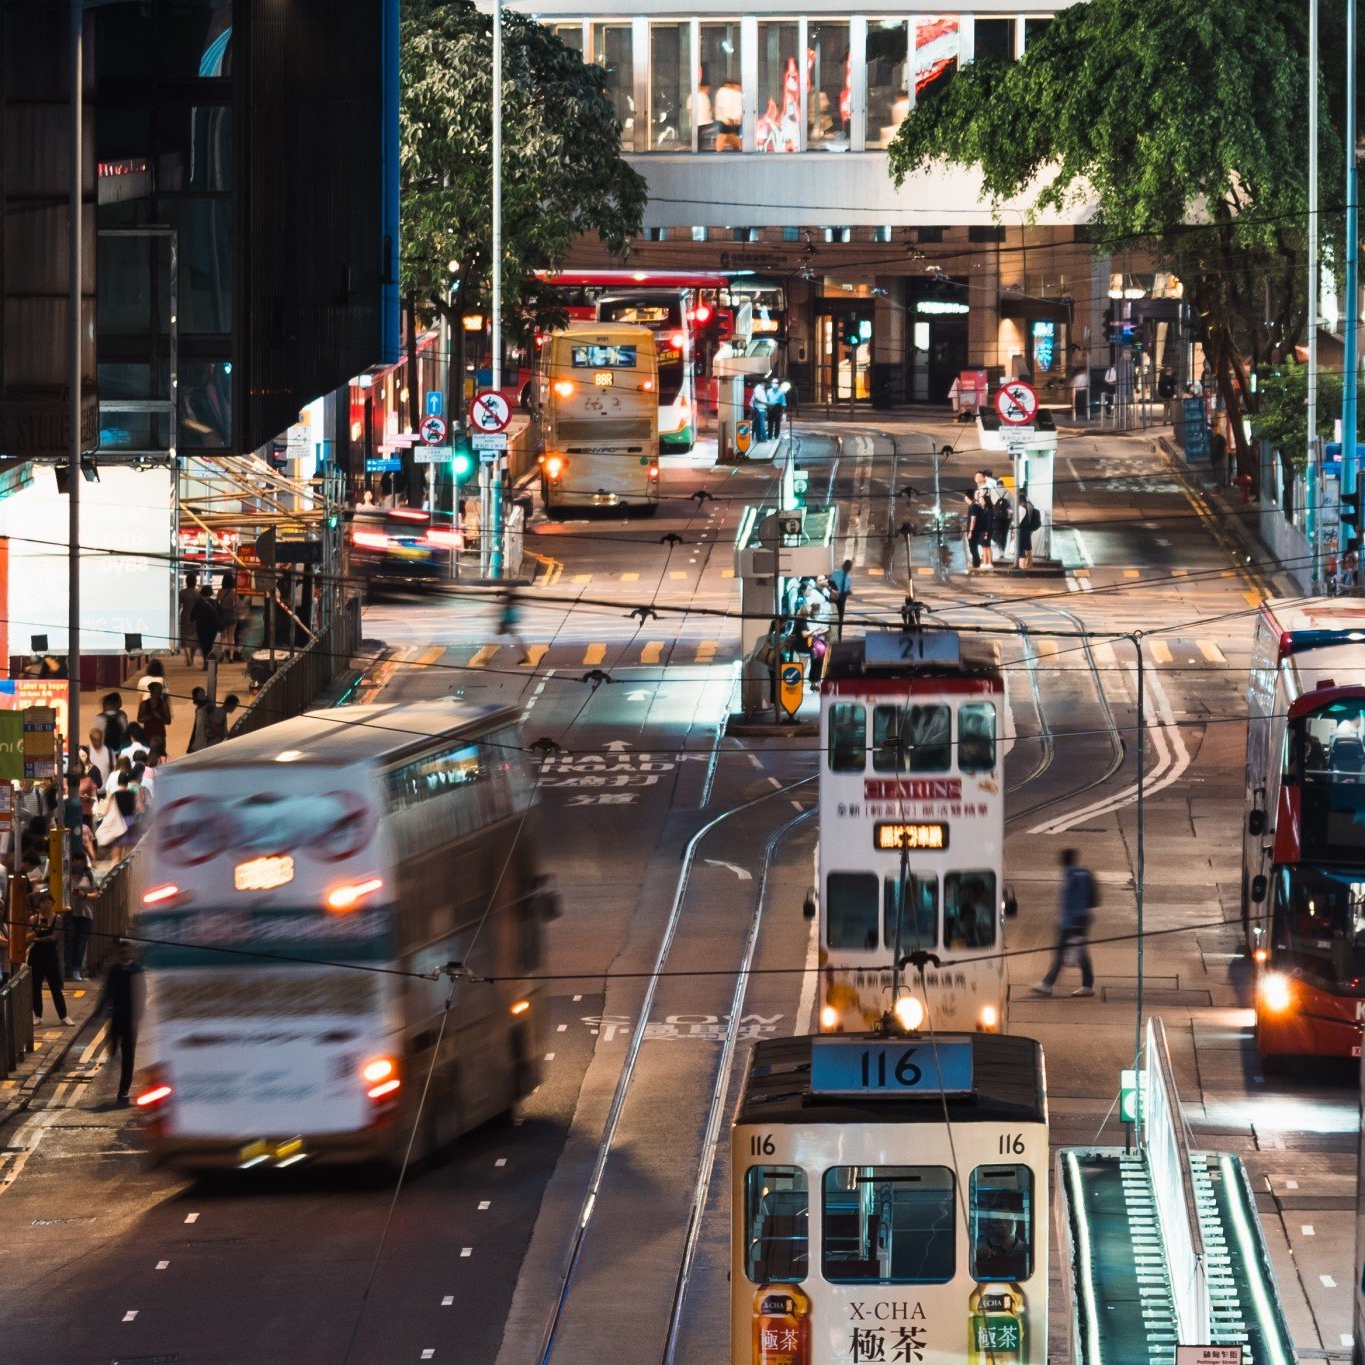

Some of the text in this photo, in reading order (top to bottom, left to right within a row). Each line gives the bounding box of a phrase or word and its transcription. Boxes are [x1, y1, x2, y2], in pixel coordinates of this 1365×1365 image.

[898, 637, 924, 660] 21
[540, 762, 675, 772] ROAD
[861, 1049, 922, 1087] 116
[751, 1134, 776, 1156] 116
[999, 1133, 1025, 1155] 116
[849, 1301, 927, 1321] X-CHA
[760, 1329, 799, 1351] 極茶
[849, 1326, 928, 1364] 極茶
[977, 1325, 1018, 1348] 極茶
